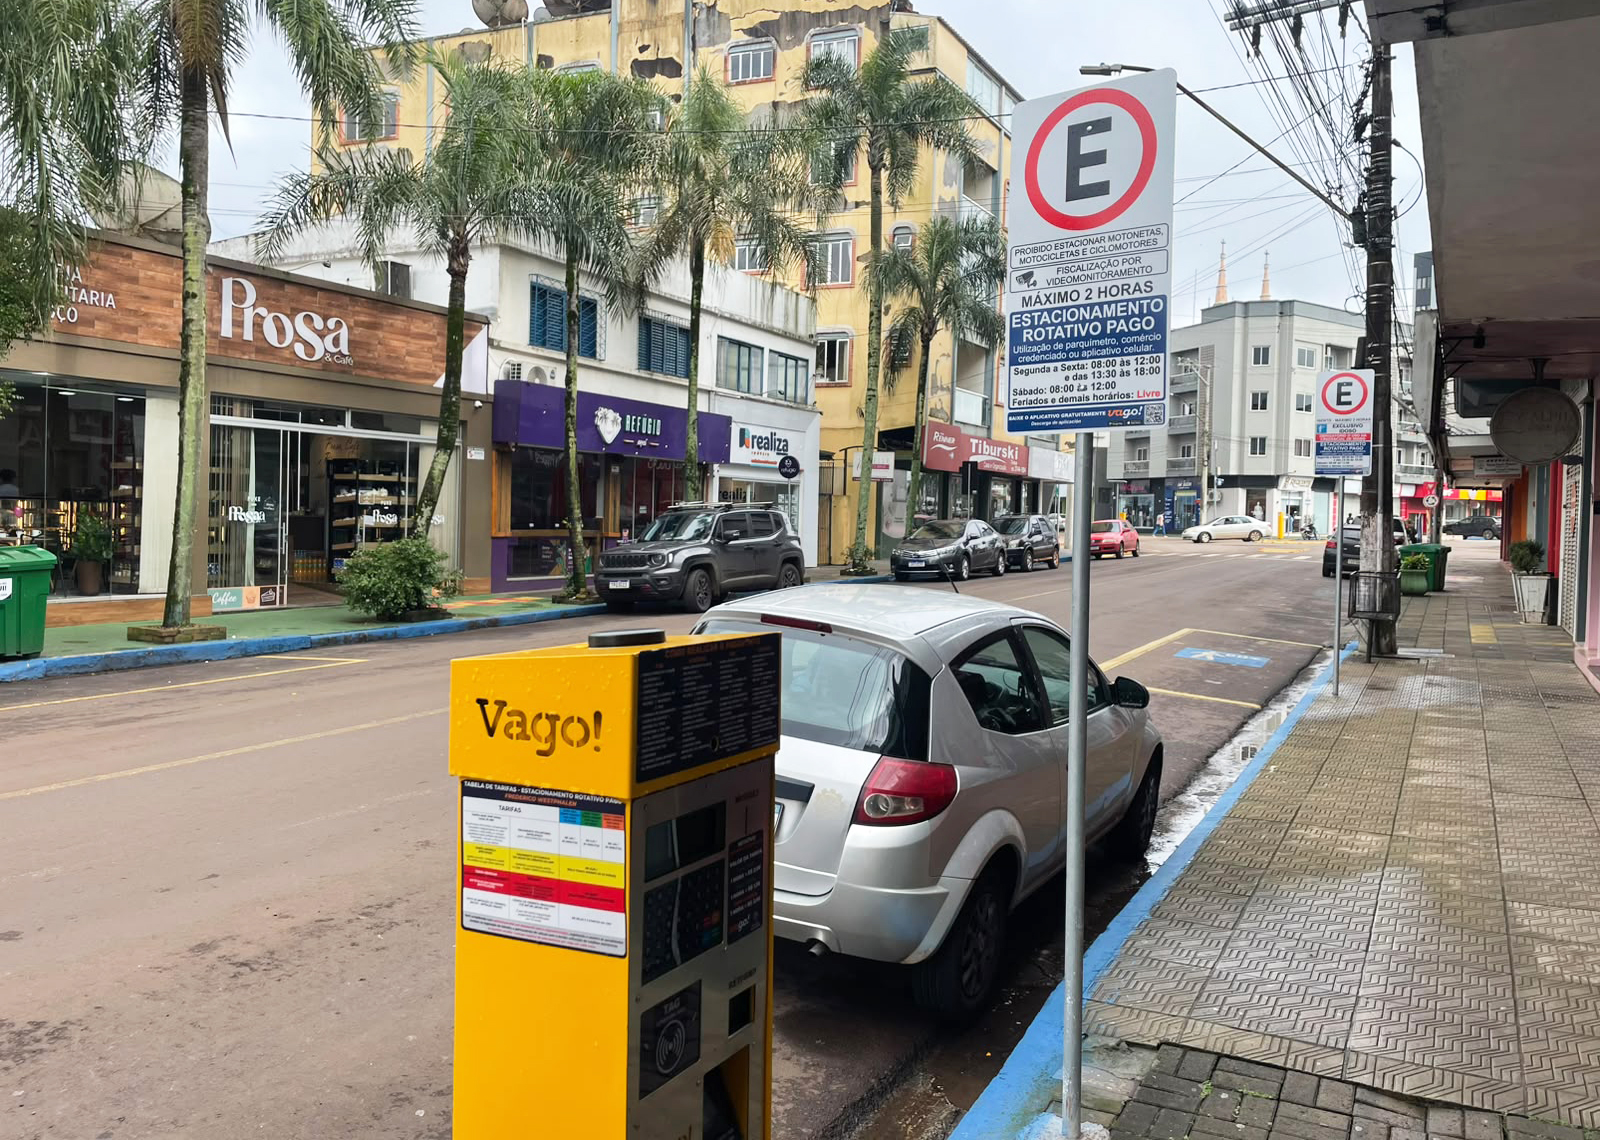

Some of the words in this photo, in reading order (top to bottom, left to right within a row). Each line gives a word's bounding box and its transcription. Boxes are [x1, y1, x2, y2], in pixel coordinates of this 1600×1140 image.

[1066, 116, 1112, 203] E
[1014, 243, 1052, 257] PROIBIDO
[1054, 237, 1106, 251] ESTACIONAR
[1107, 228, 1164, 243] MOTONETAS,
[1019, 250, 1080, 265] MOTOCICLETAS
[1081, 248, 1088, 256] E
[1089, 238, 1158, 255] CICLOMOTORES
[1046, 266, 1152, 287] VIDEOMONITORAMENTO
[1056, 259, 1120, 276] FISCALIZAÇÃO
[1121, 256, 1142, 267] POR
[1021, 289, 1080, 309] MÁXIMO
[1084, 288, 1093, 301] 2
[1097, 281, 1154, 299] HORAS
[220, 277, 350, 363] Prosa
[1011, 298, 1164, 328] ESTACIONAMENTO
[1023, 321, 1102, 342] ROTATIVO
[1106, 315, 1155, 334] PAGO
[1013, 342, 1051, 354] Utilização
[1053, 341, 1064, 351] de
[1065, 338, 1119, 351] parquímetro,
[1121, 333, 1162, 344] comércio
[1018, 351, 1067, 363] credenciado
[1068, 351, 1079, 359] ou
[1081, 347, 1122, 359] aplicativo
[1123, 344, 1155, 354] celular.
[1013, 365, 1051, 377] Segunda
[1060, 361, 1088, 372] Sexta:
[1091, 359, 1117, 370] 08:00
[1119, 358, 1131, 367] às
[1134, 355, 1161, 365] 12:00
[1072, 372, 1088, 381] das
[1091, 369, 1117, 379] 13:30
[1119, 368, 1131, 377] às
[1134, 365, 1161, 376] 18:00
[1012, 386, 1047, 397] Sábado:
[1049, 384, 1074, 394] 08:00
[1091, 381, 1116, 391] 12:00
[1012, 395, 1049, 407] Feriados
[1058, 393, 1090, 404] demais
[1092, 391, 1134, 401] horários:
[1137, 389, 1161, 399] Livre
[1336, 382, 1353, 406] E
[625, 413, 661, 436] REFÚGIO
[1030, 413, 1060, 421] APLICATIVO
[1060, 410, 1106, 419] GRATUITAMENTE
[751, 431, 789, 453] realiza
[970, 438, 1019, 461] Tiburski
[372, 509, 398, 525] Prosa
[212, 591, 238, 605] Coffee
[476, 698, 602, 757] Vago!
[464, 780, 485, 790] TABELA
[494, 784, 517, 793] TARIFAS
[520, 788, 574, 800] ESTACIONAMENTO
[574, 794, 604, 803] ROTATIVO
[504, 794, 537, 804] FREDERICO
[499, 804, 522, 814] TARIFAS
